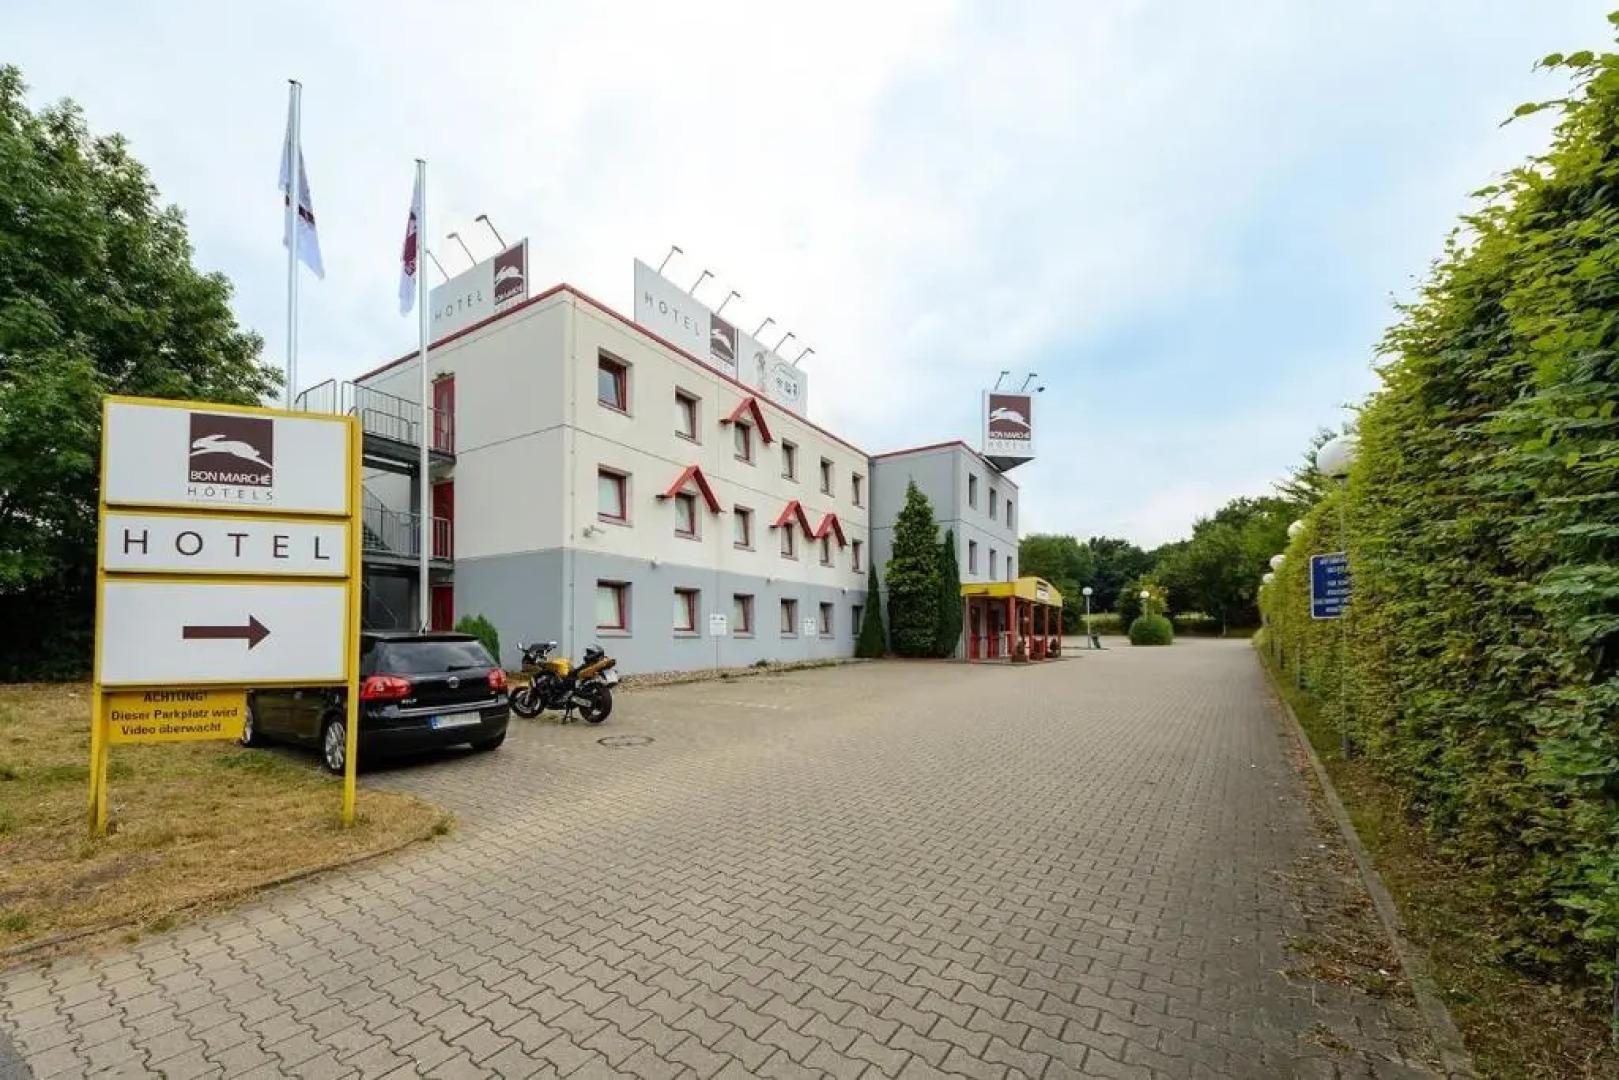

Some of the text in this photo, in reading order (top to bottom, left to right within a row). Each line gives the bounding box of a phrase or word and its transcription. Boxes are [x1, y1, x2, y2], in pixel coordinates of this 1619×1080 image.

[434, 290, 483, 320] HOTEL
[644, 291, 700, 336] HOTEL
[190, 470, 272, 485] BON MARCHÉ
[187, 486, 273, 501] HOTELS
[124, 529, 330, 560] HOTEL
[143, 690, 208, 703] ACHTUNG!
[111, 707, 238, 721] Dieser Parkplatz wird
[121, 722, 221, 735] Video überwacht
